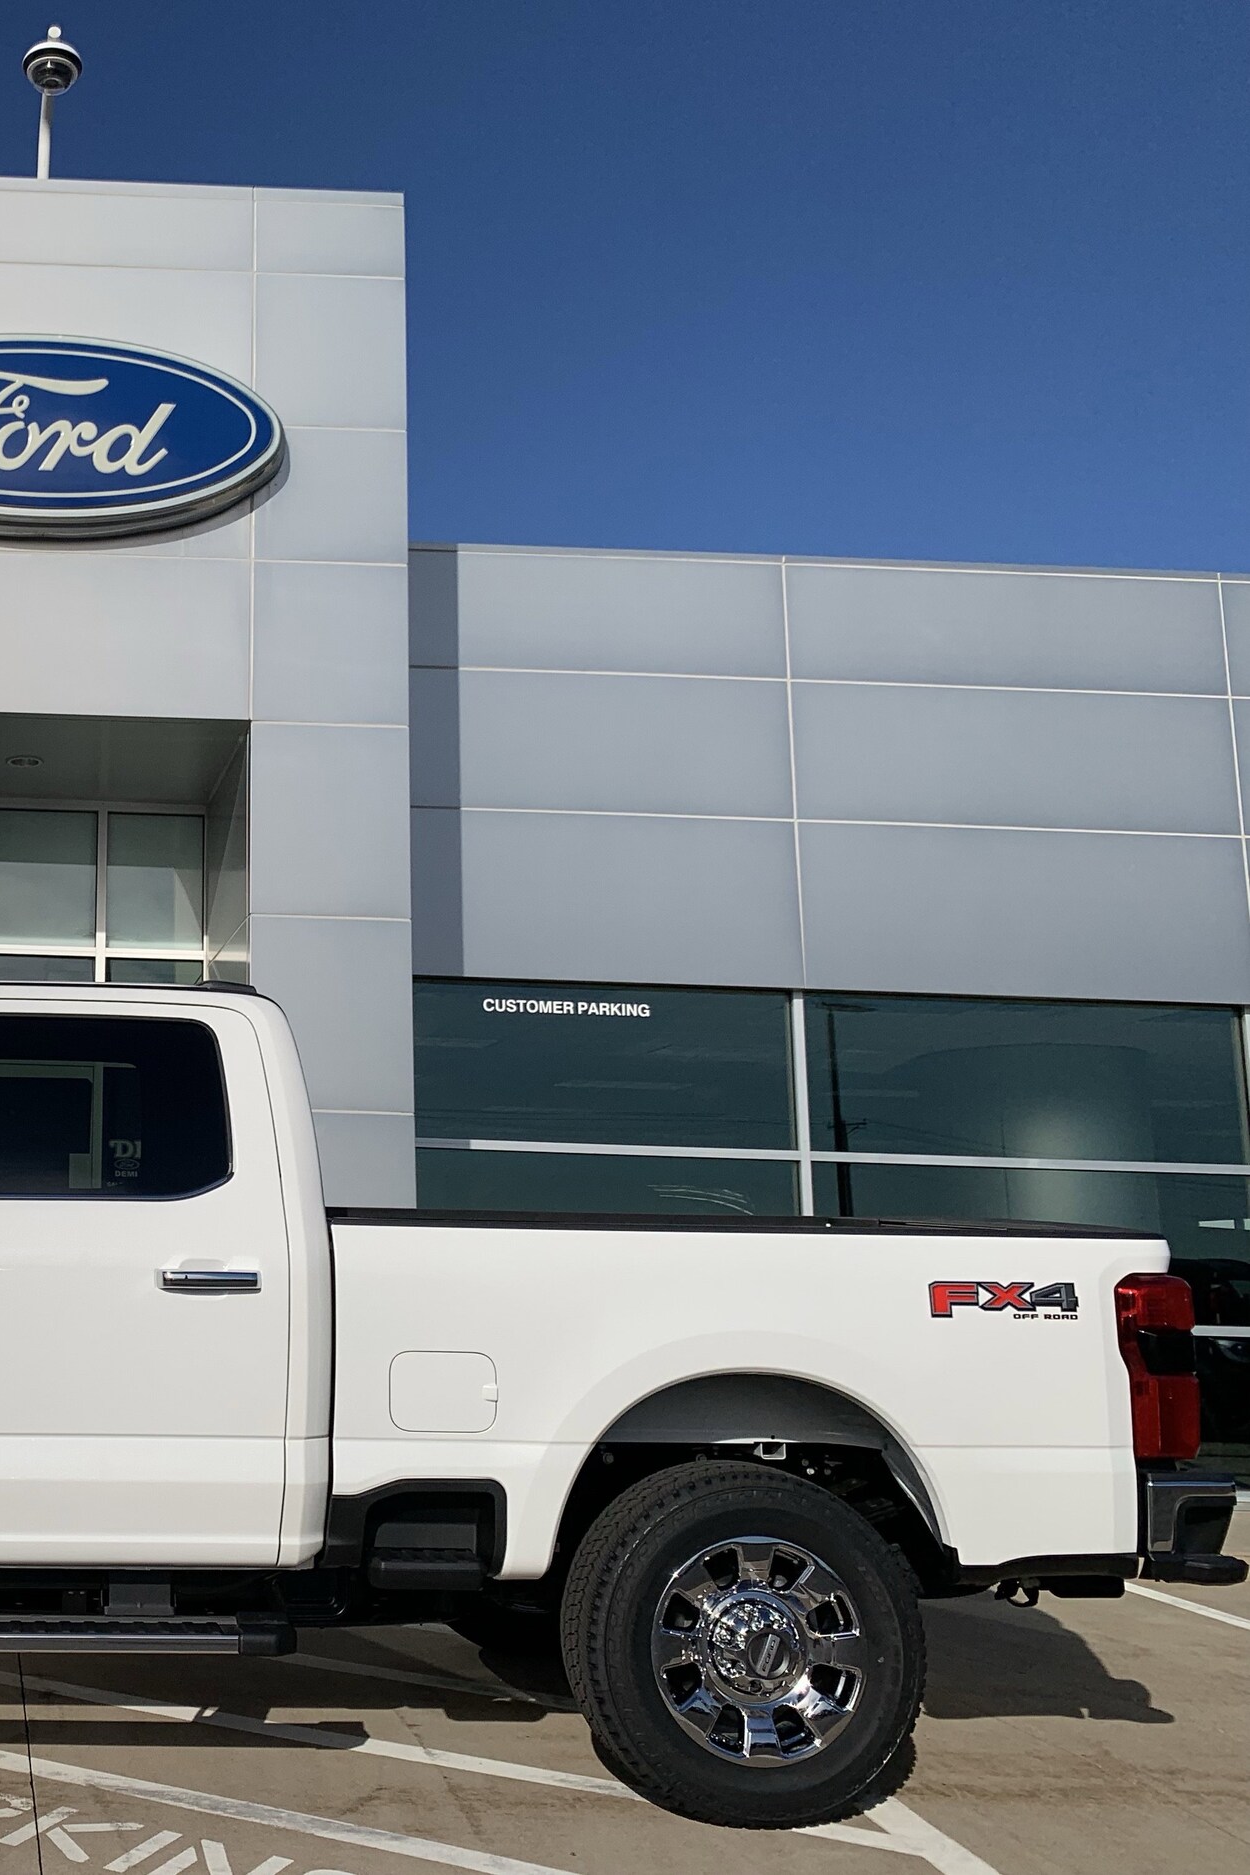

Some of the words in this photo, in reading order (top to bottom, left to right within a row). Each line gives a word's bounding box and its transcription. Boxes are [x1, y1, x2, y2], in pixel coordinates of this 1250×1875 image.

[482, 998, 575, 1015] CUSTOMER
[577, 1001, 651, 1018] PARKING
[928, 1281, 1079, 1318] FX4
[1044, 1313, 1079, 1321] ROAD
